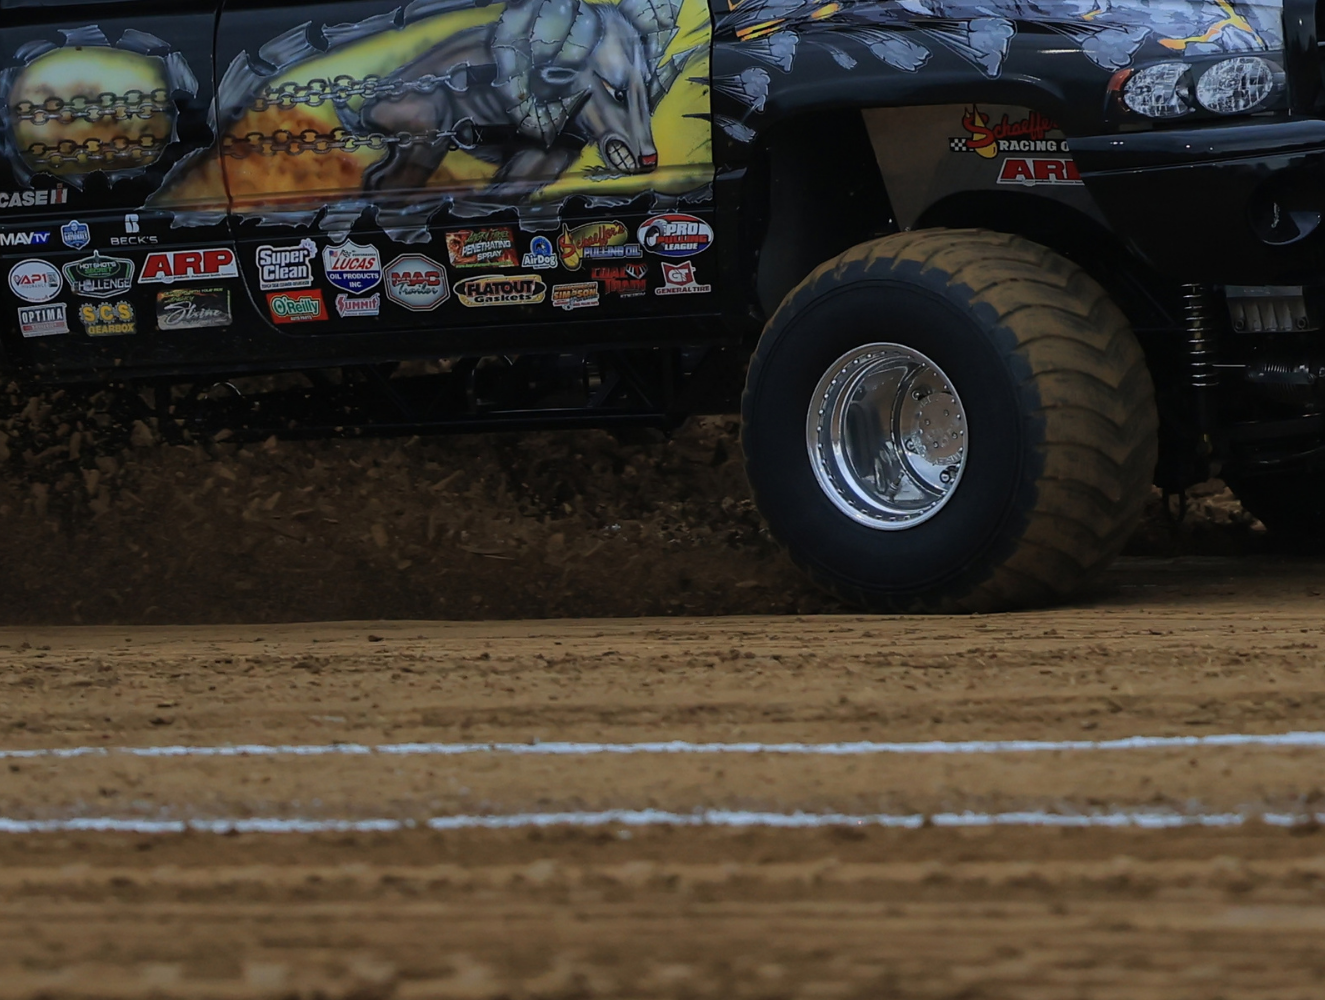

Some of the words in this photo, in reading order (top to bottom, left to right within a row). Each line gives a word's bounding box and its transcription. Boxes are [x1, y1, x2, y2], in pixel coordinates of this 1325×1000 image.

[999, 139, 1057, 152] RACING
[665, 222, 699, 236] PRO
[110, 236, 159, 246] BECK'S
[664, 242, 698, 251] LEAGUE
[259, 249, 309, 266] Super
[477, 249, 503, 260] SPRAY
[583, 246, 624, 258] PULLING
[625, 244, 641, 257] OIL
[142, 250, 233, 278] ARP
[332, 257, 376, 270] LUCAS
[524, 253, 558, 267] AirDog
[262, 265, 308, 281] Clean
[343, 272, 379, 280] PRODUCTS
[391, 271, 441, 286] MAC
[396, 282, 439, 296] Trailer
[467, 280, 535, 296] FLATOUT
[553, 289, 597, 300] SIMPSON
[656, 286, 689, 294] GENERAL
[689, 285, 711, 293] TIRE
[474, 294, 532, 303] Gaskets
[274, 296, 319, 316] O'Reilly
[21, 307, 63, 324] OPTIMA
[88, 322, 135, 334] GEARBOX
